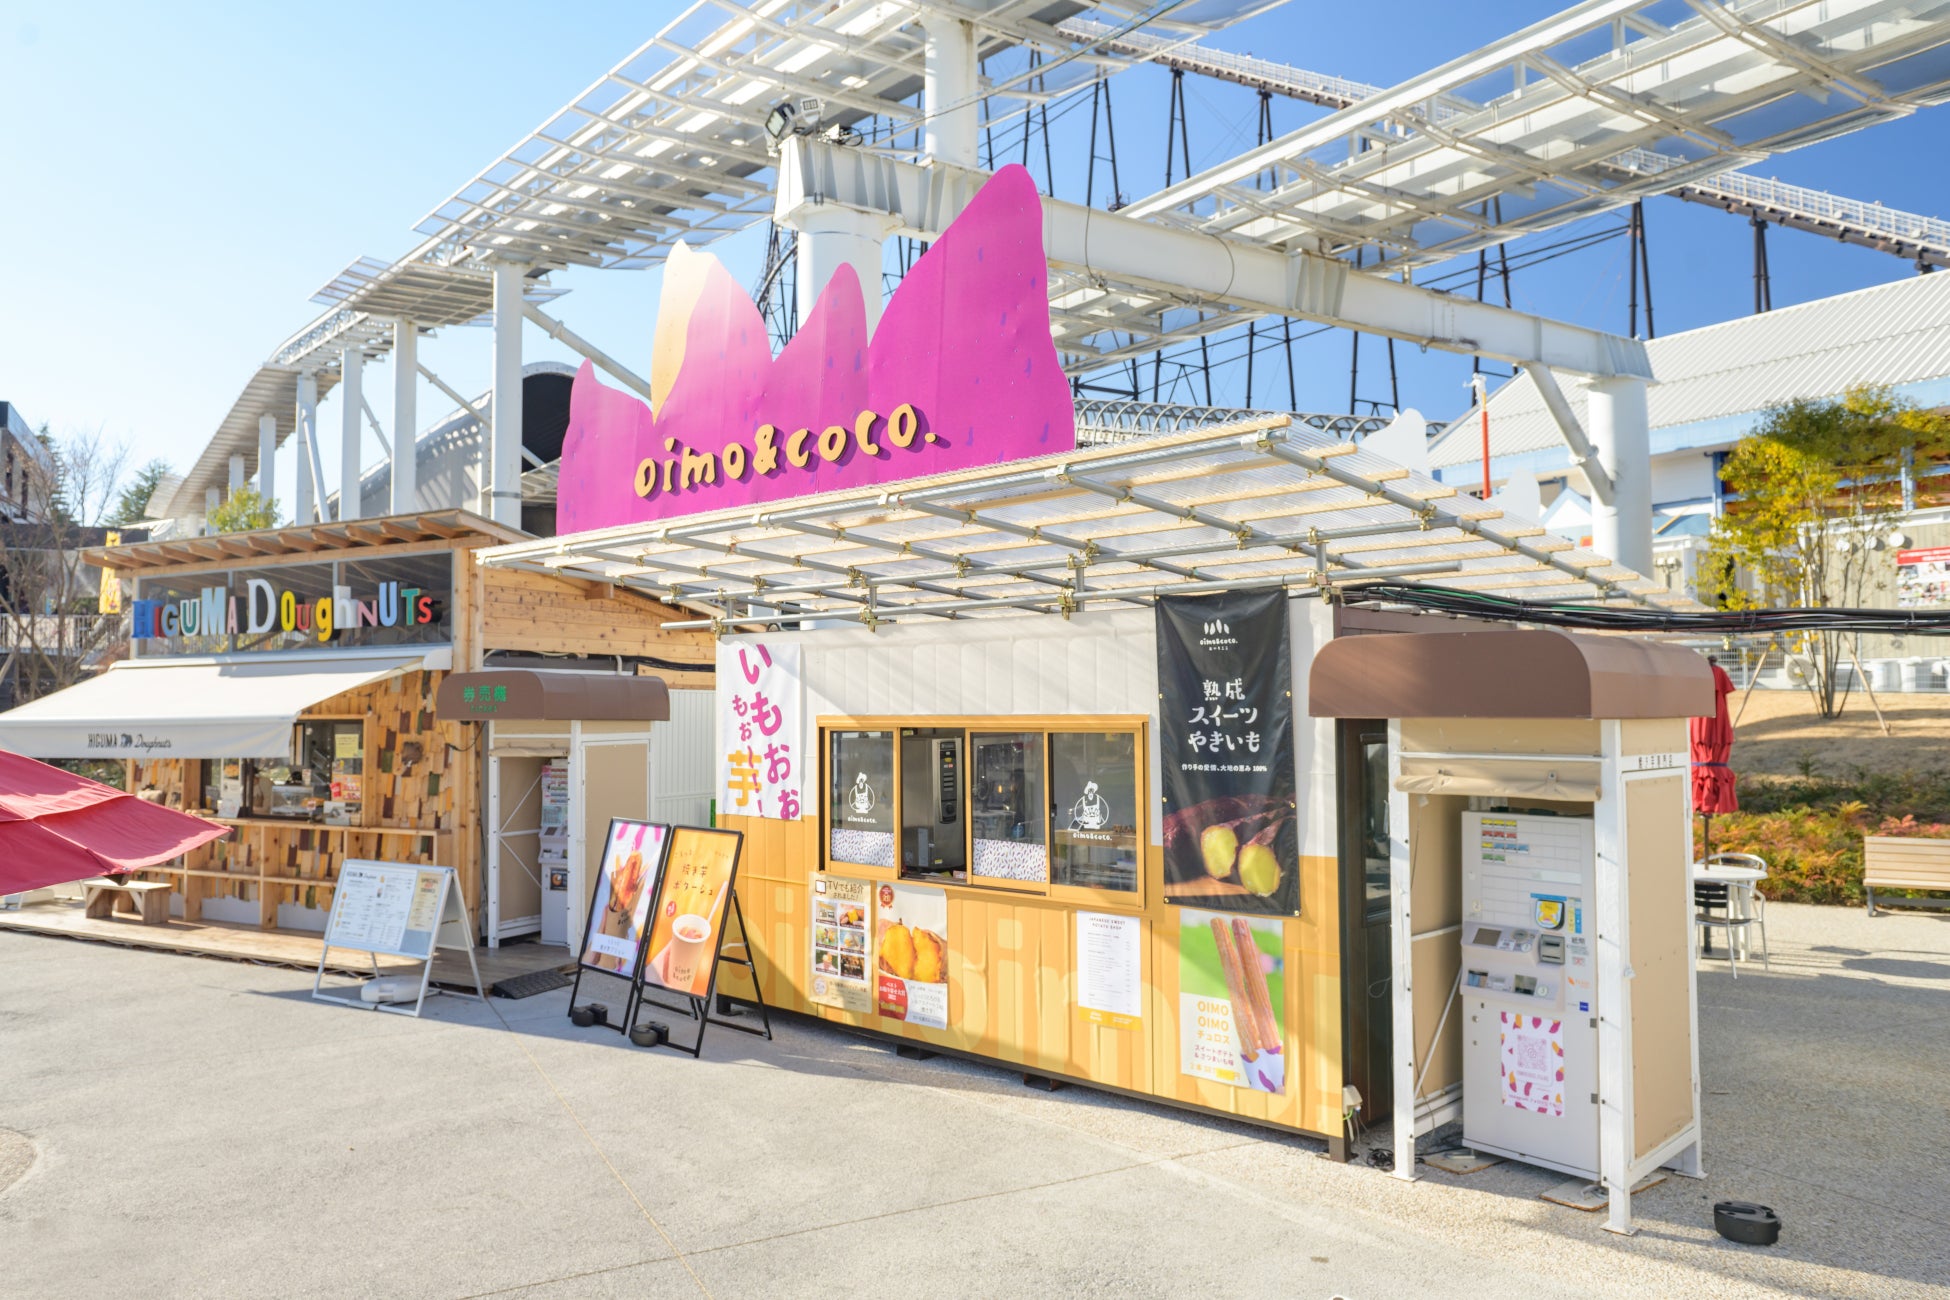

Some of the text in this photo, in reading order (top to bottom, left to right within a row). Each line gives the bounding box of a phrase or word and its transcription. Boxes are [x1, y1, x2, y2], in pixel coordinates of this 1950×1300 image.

[634, 402, 938, 498] oimo&coco.
[132, 586, 239, 638] HIGUMA
[1202, 677, 1246, 701] 熟成
[1188, 704, 1259, 727] スイーツ
[1188, 730, 1261, 753] やきいも
[727, 749, 763, 807] 芋
[1197, 1000, 1230, 1017] OIMO
[1197, 1015, 1230, 1033] OIMO
